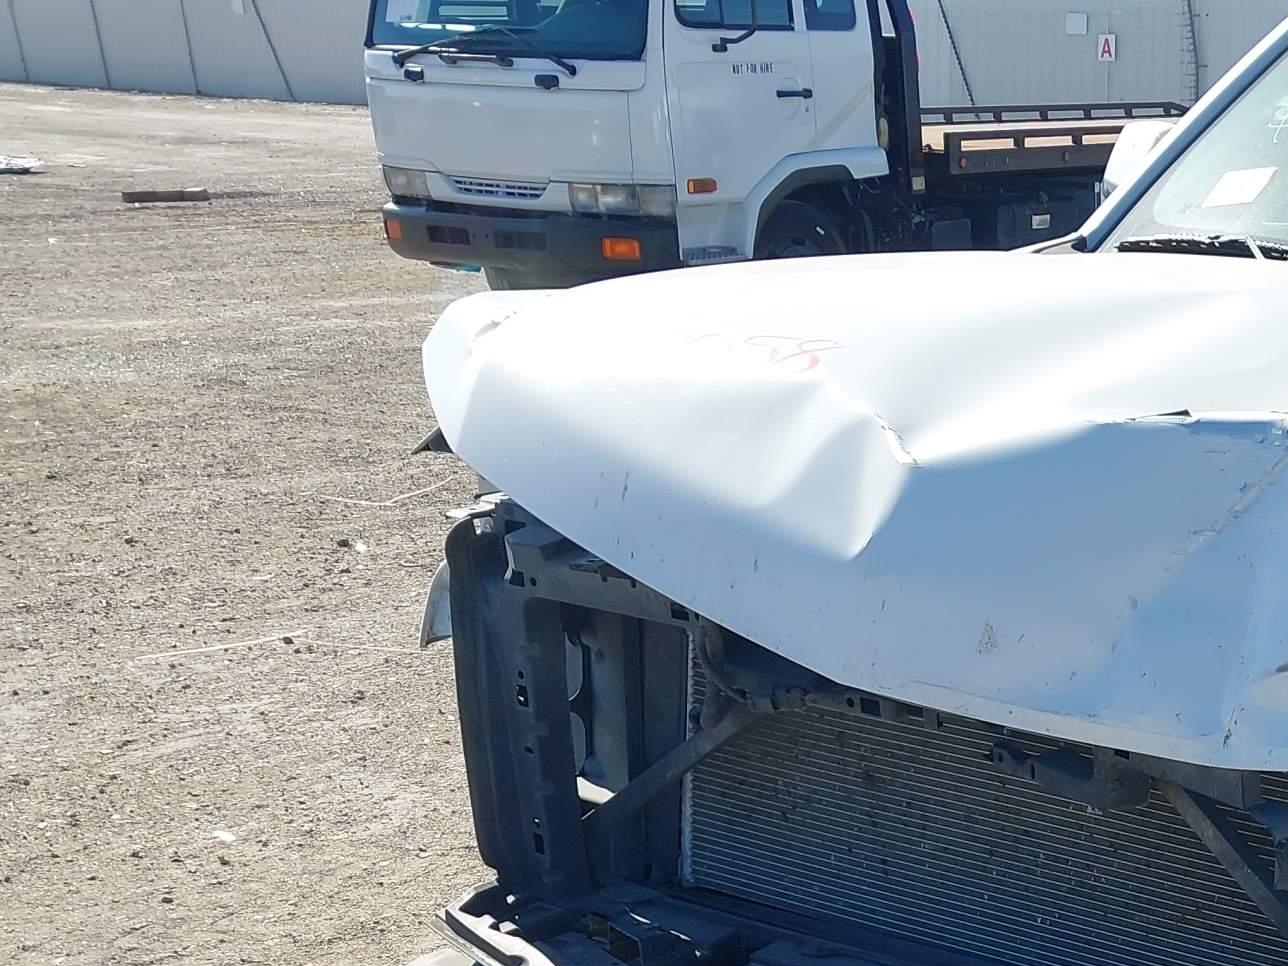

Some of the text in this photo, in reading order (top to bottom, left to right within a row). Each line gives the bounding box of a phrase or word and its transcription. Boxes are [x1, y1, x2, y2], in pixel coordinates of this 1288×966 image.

[1100, 37, 1113, 58] A
[732, 62, 774, 74] NOT FOR HIRE
